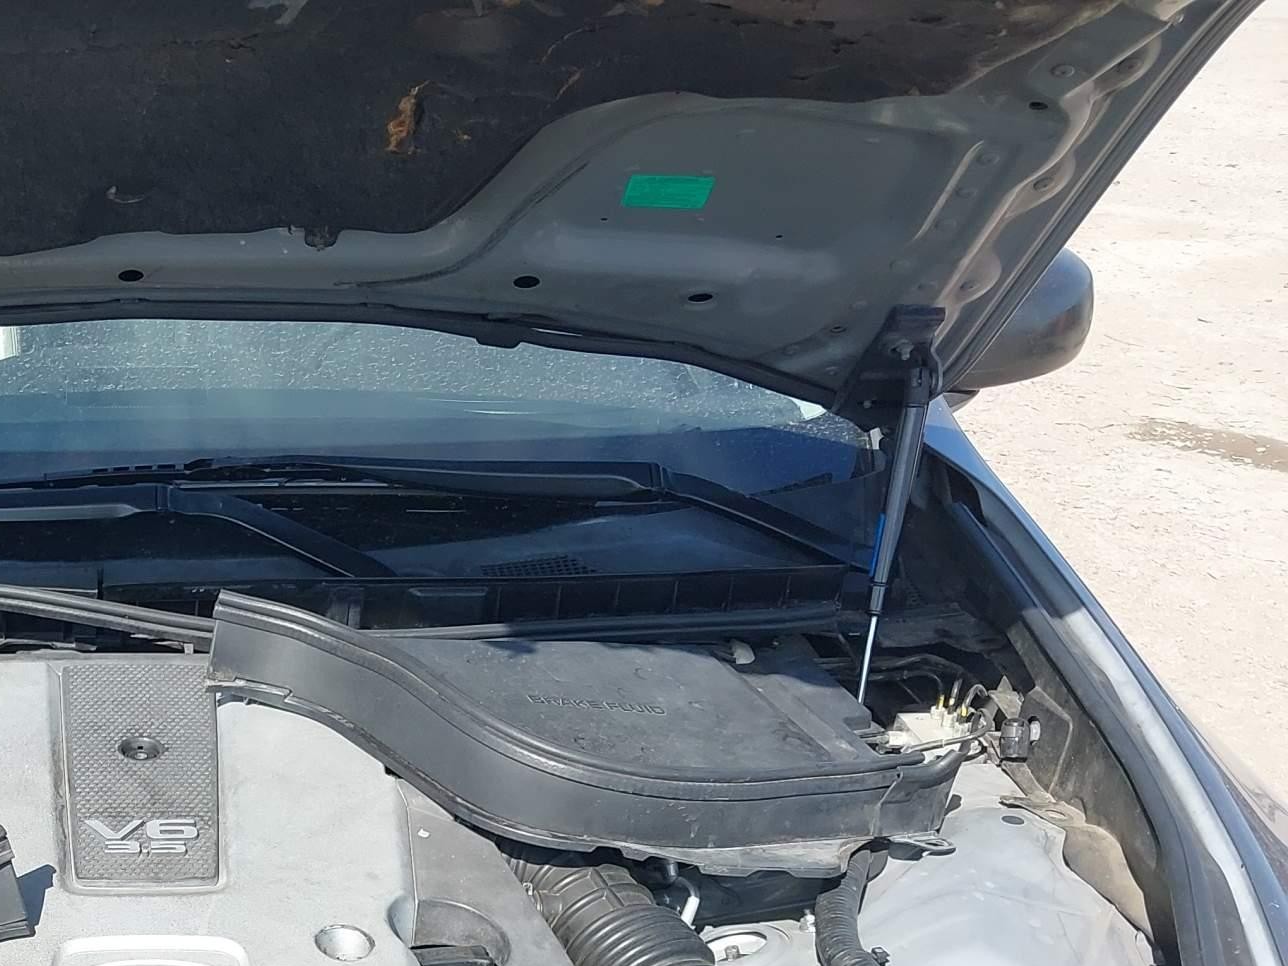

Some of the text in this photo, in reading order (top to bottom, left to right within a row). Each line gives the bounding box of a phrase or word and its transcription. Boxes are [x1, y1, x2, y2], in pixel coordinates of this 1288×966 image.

[527, 694, 667, 716] BRAKE FLUID
[83, 818, 199, 840] V6
